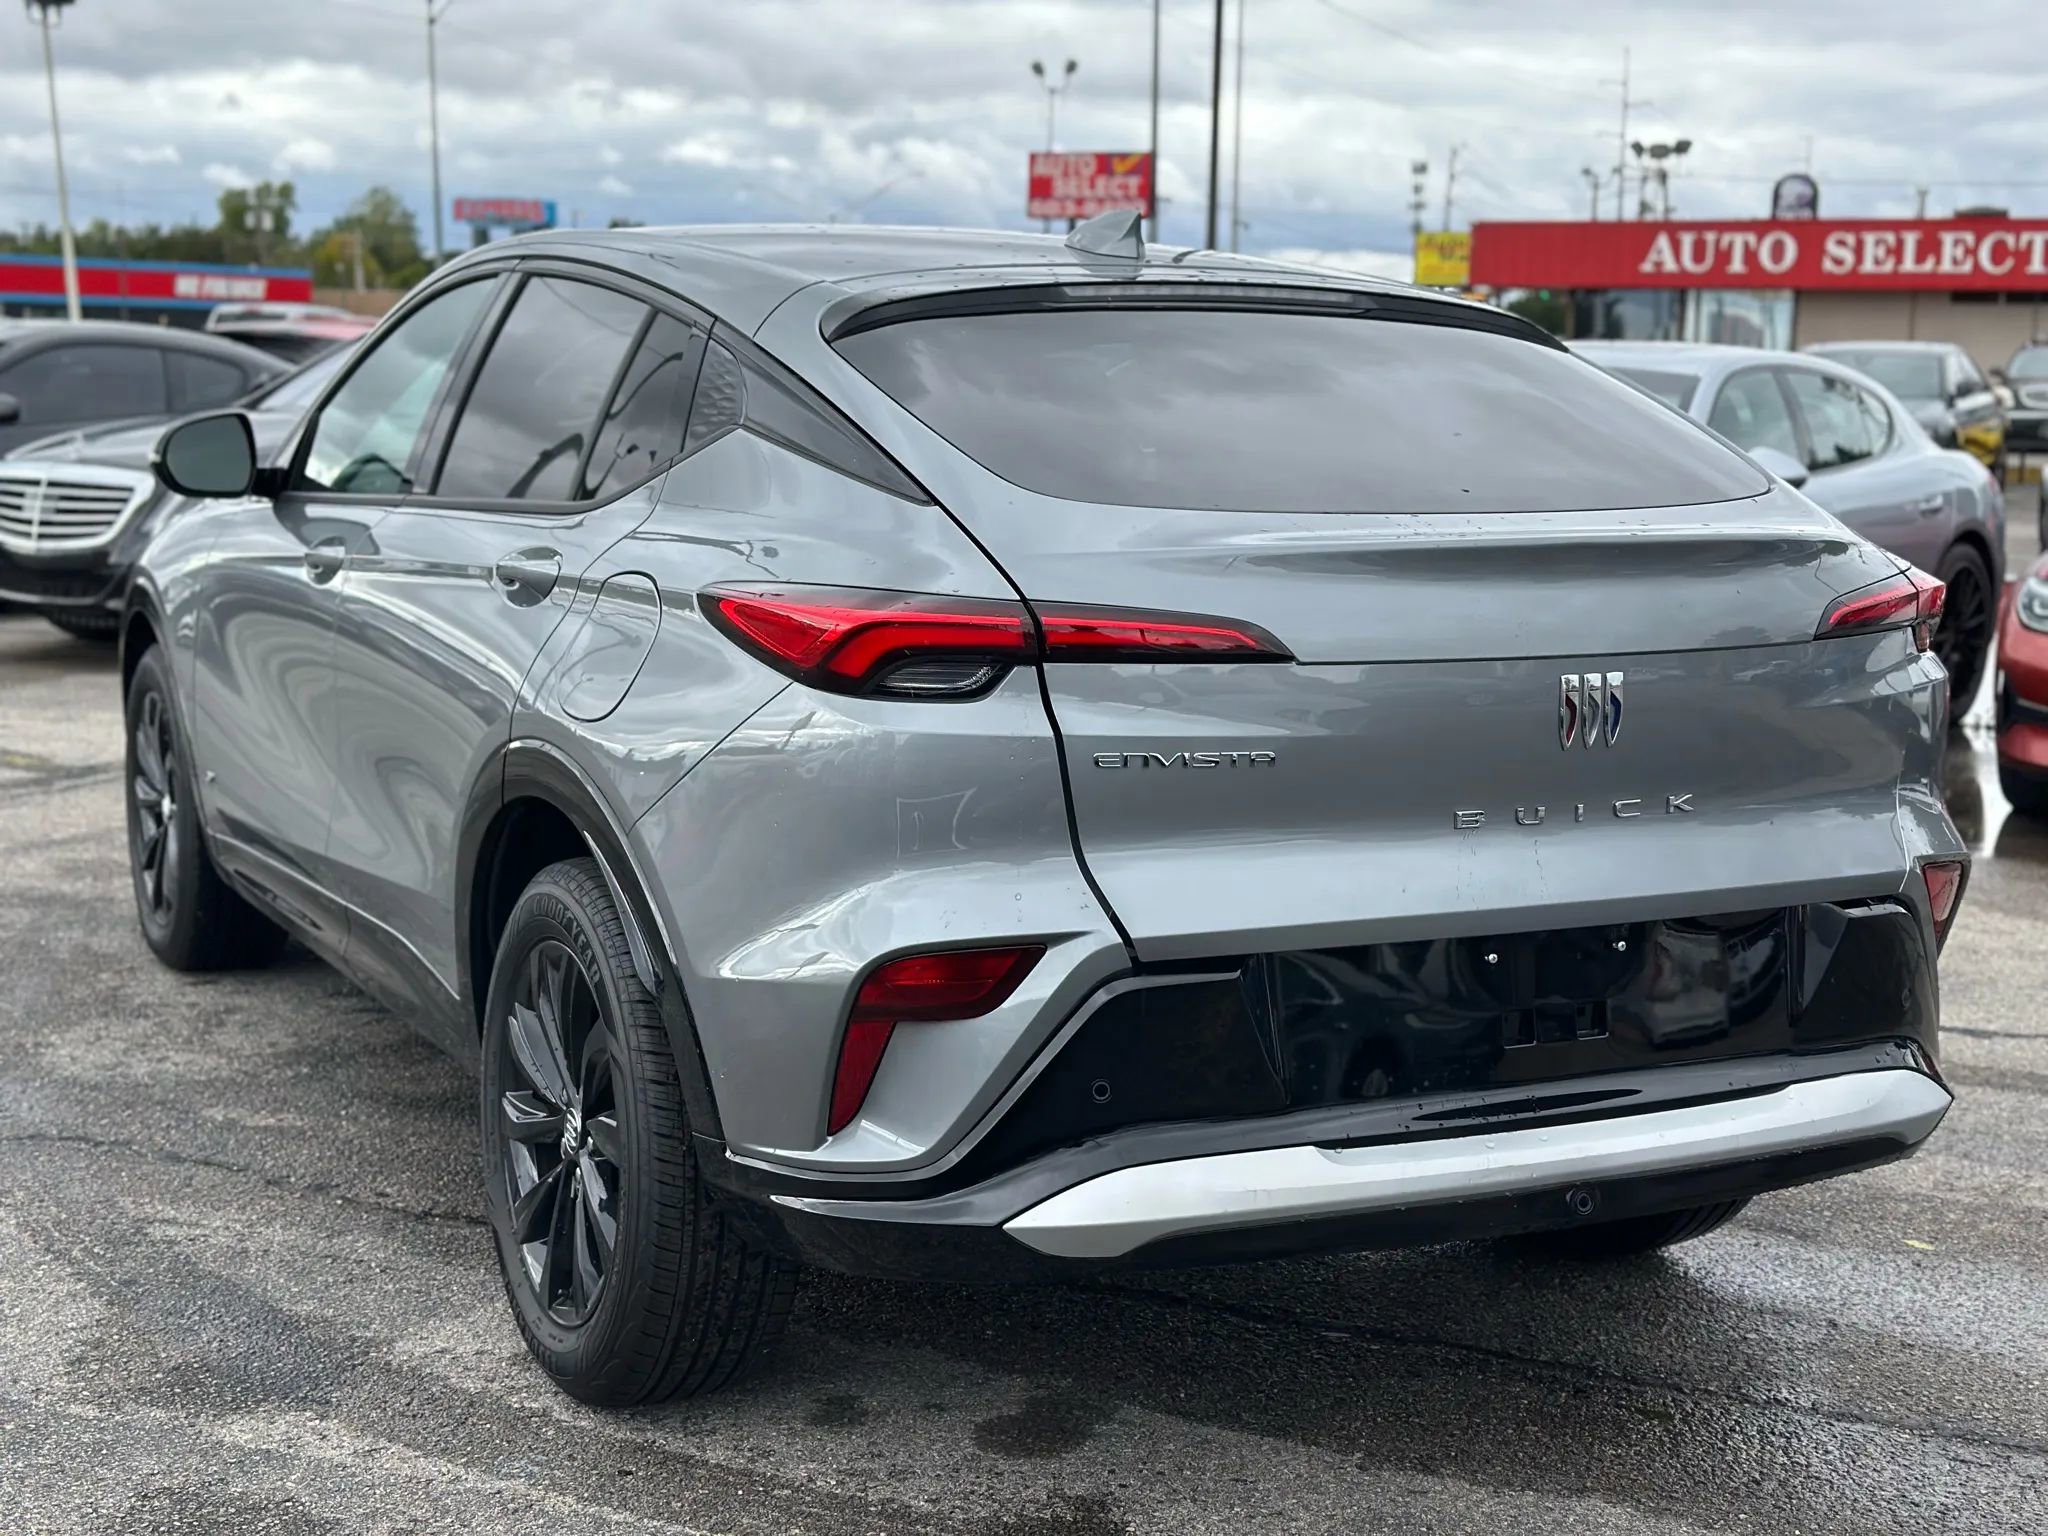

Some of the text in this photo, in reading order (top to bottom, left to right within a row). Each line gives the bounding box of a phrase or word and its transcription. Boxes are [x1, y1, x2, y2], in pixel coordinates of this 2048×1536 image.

[1033, 152, 1097, 177] AUTO
[1051, 176, 1140, 200] SELECT
[1638, 230, 2048, 275] AUTO SELECT
[1093, 751, 1276, 768] ENVISTA
[1454, 793, 1695, 830] BUICK
